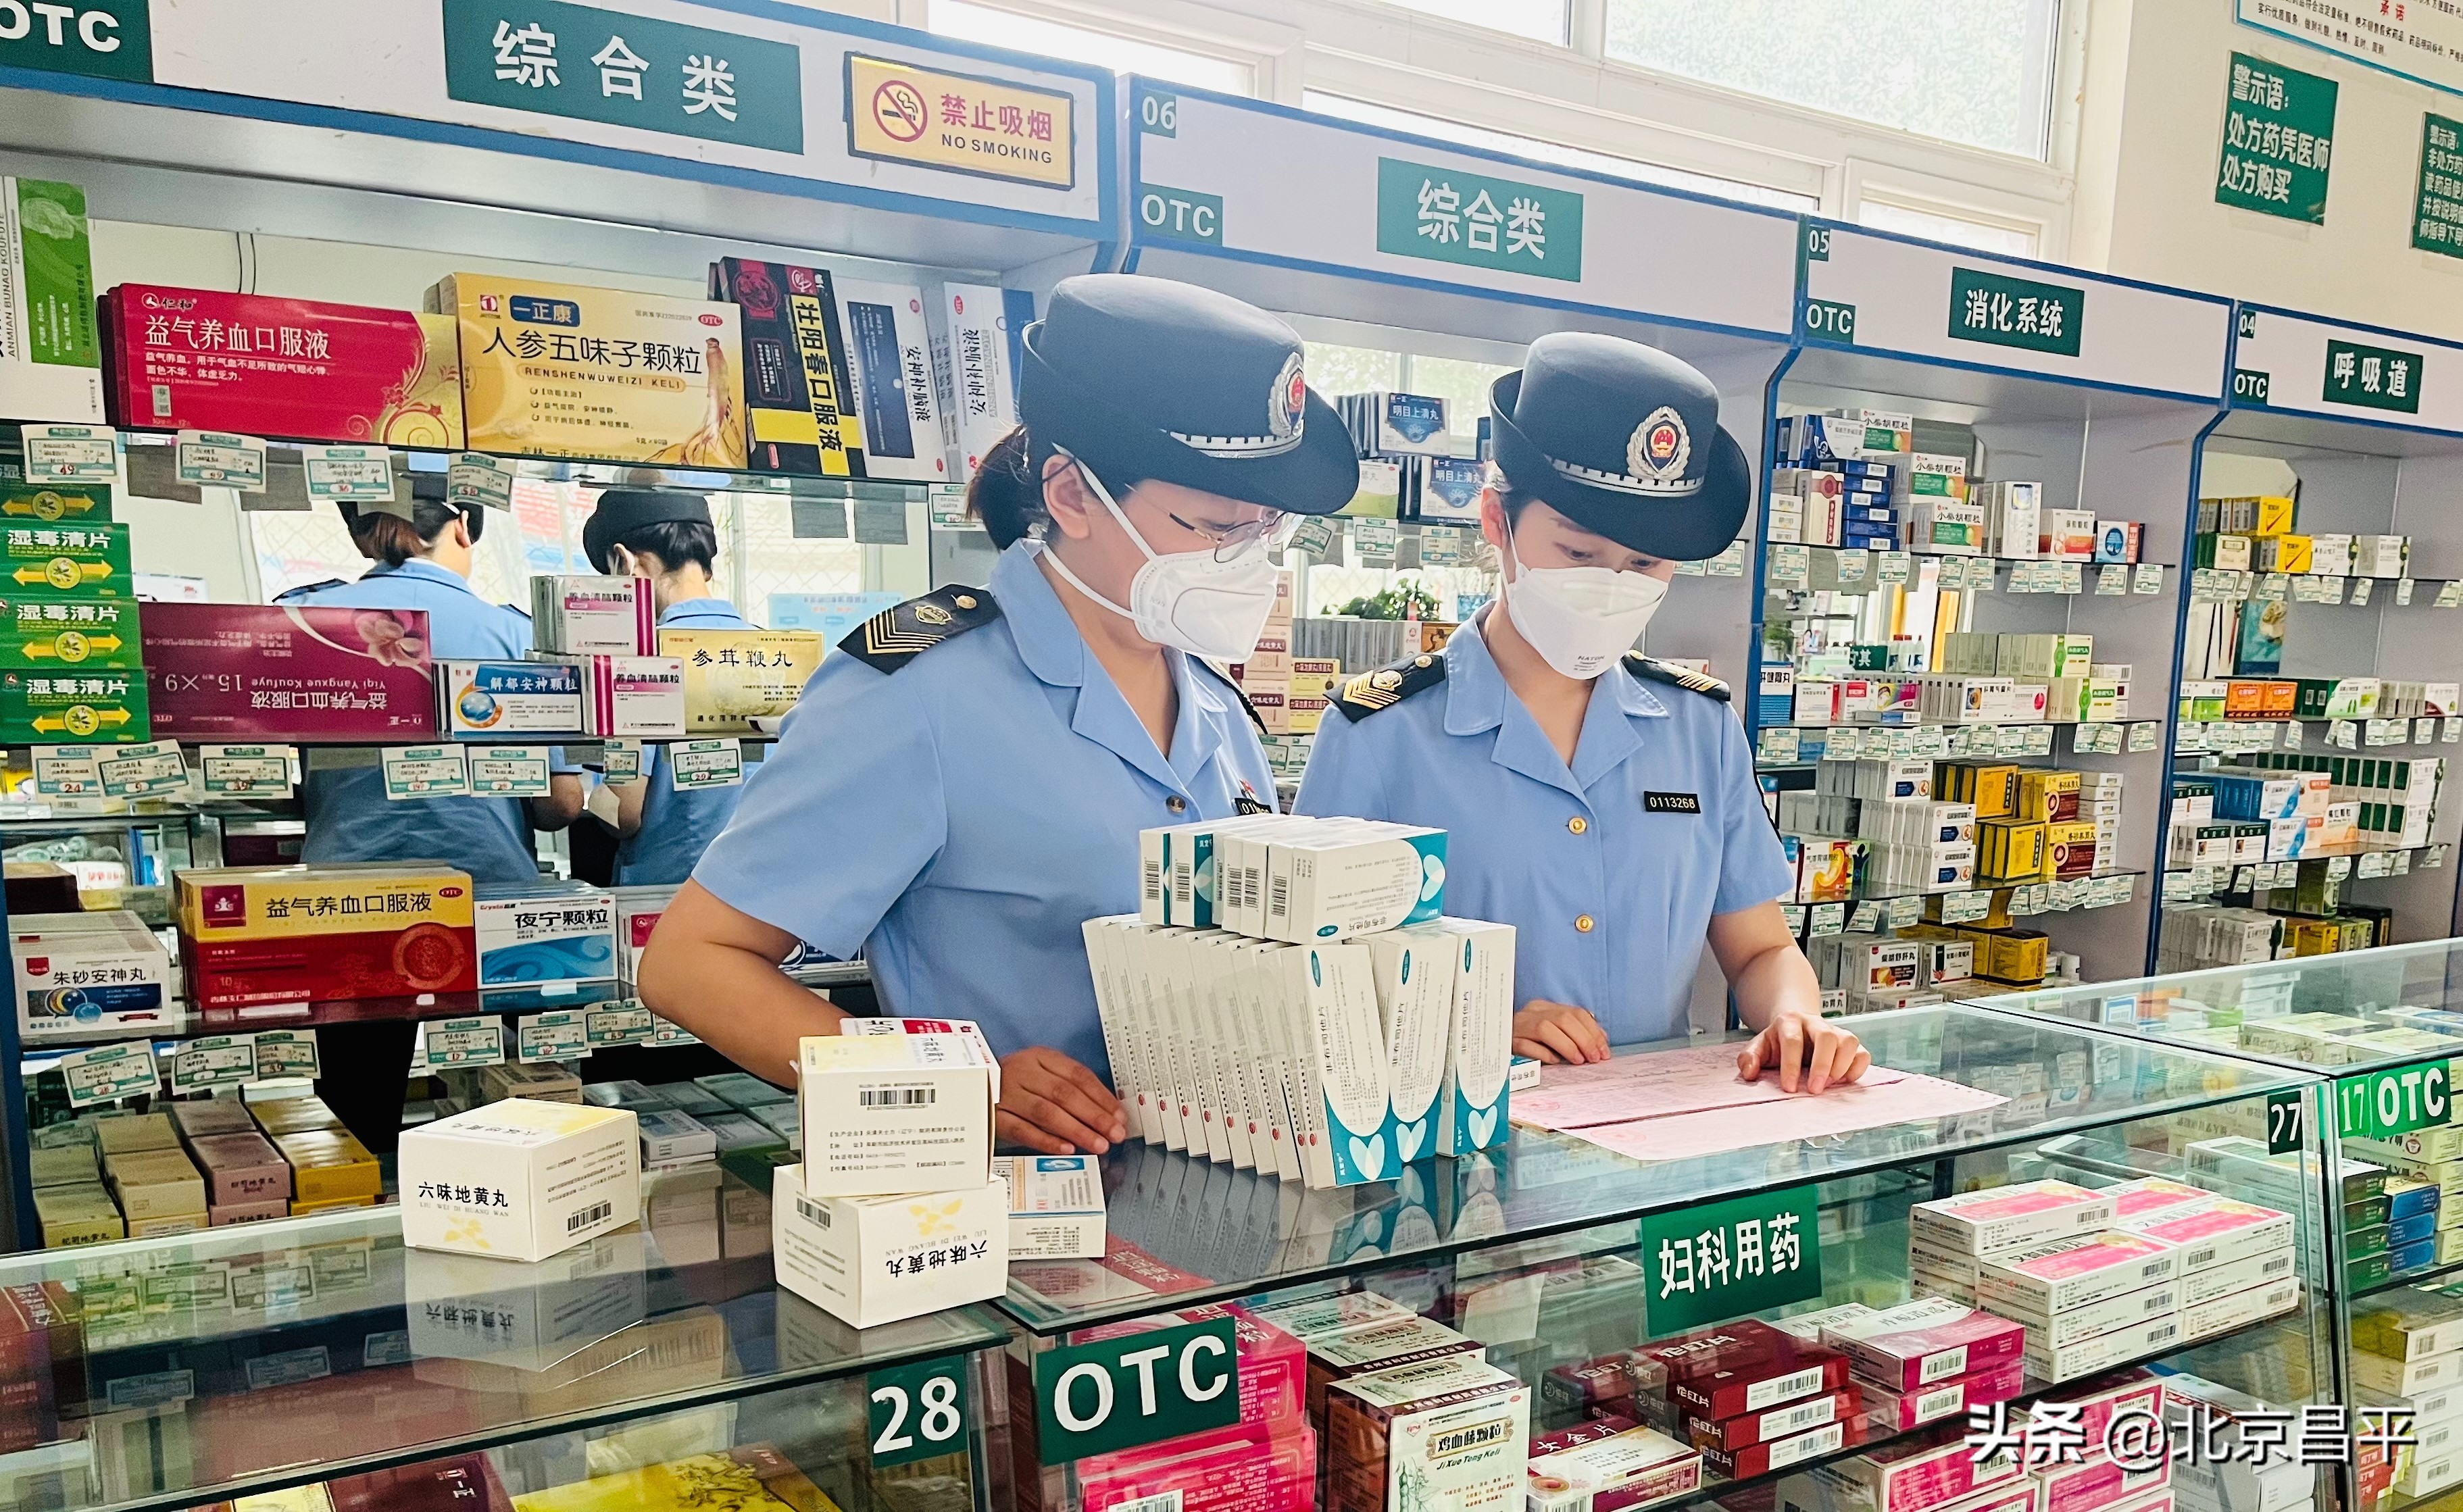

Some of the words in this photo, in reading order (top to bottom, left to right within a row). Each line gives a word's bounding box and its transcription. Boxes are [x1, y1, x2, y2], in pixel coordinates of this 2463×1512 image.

[0, 1, 120, 52] OTC
[491, 21, 739, 122] 综合类
[940, 93, 1052, 142] 禁止吸烟
[1141, 96, 1176, 129] 06
[941, 134, 966, 150] NO
[970, 137, 1053, 163] SMOKING
[2226, 111, 2331, 172] 处方药凭医师
[2220, 154, 2291, 203] 处方购买
[1141, 194, 1215, 236] OTC
[1417, 178, 1546, 260] 综合类
[1809, 230, 1828, 253] 05
[514, 302, 572, 324] 一正康
[954, 296, 963, 315] OTC
[1965, 288, 2063, 337] 消化系统
[700, 315, 722, 326] OTC
[1806, 305, 1852, 334] OTC
[2240, 313, 2254, 336] 04
[145, 314, 331, 359] 益气养血口服液
[482, 327, 702, 374] 人参五味子颗粒
[525, 367, 643, 386] RENSHENWUWEIZI
[651, 379, 680, 390] KELI
[795, 303, 843, 452] 壮阳春口服液
[905, 346, 930, 422] 安神补脑液
[963, 328, 986, 415] 安神补脑液
[2333, 352, 2407, 399] 呼吸道
[2234, 374, 2267, 398] OTC
[1393, 405, 1439, 421] 明目上清丸
[8, 530, 111, 549] 湿毒清片
[18, 605, 119, 622] 湿毒清片
[693, 648, 793, 667] 参茸鞭丸
[26, 678, 129, 695] 湿毒清片
[251, 678, 302, 690] Koufuye
[307, 678, 359, 690] Yangxue
[362, 678, 386, 689] Yiqi
[490, 676, 578, 692] 解郁安神颗粒
[250, 690, 388, 710] 益气养血口服液
[1649, 796, 1696, 810] 0113268
[266, 892, 431, 918] 益气养血口服液
[441, 888, 461, 897] OTC
[514, 909, 609, 928] 夜宁颗粒
[53, 967, 147, 985] 朱砂安神丸
[2341, 1083, 2364, 1132] 17
[2377, 1067, 2445, 1127] OTC
[2271, 1102, 2302, 1143] 27
[418, 1181, 509, 1207] 六味地黄丸
[493, 1209, 509, 1217] WAN
[953, 1234, 968, 1242] WEI
[975, 1229, 988, 1238] LIU
[885, 1249, 904, 1257] WAN
[886, 1240, 987, 1278] 六味地黄丸
[1659, 1212, 1801, 1299] 妇科用药
[1054, 1335, 1229, 1432] OTC
[872, 1376, 962, 1454] 28
